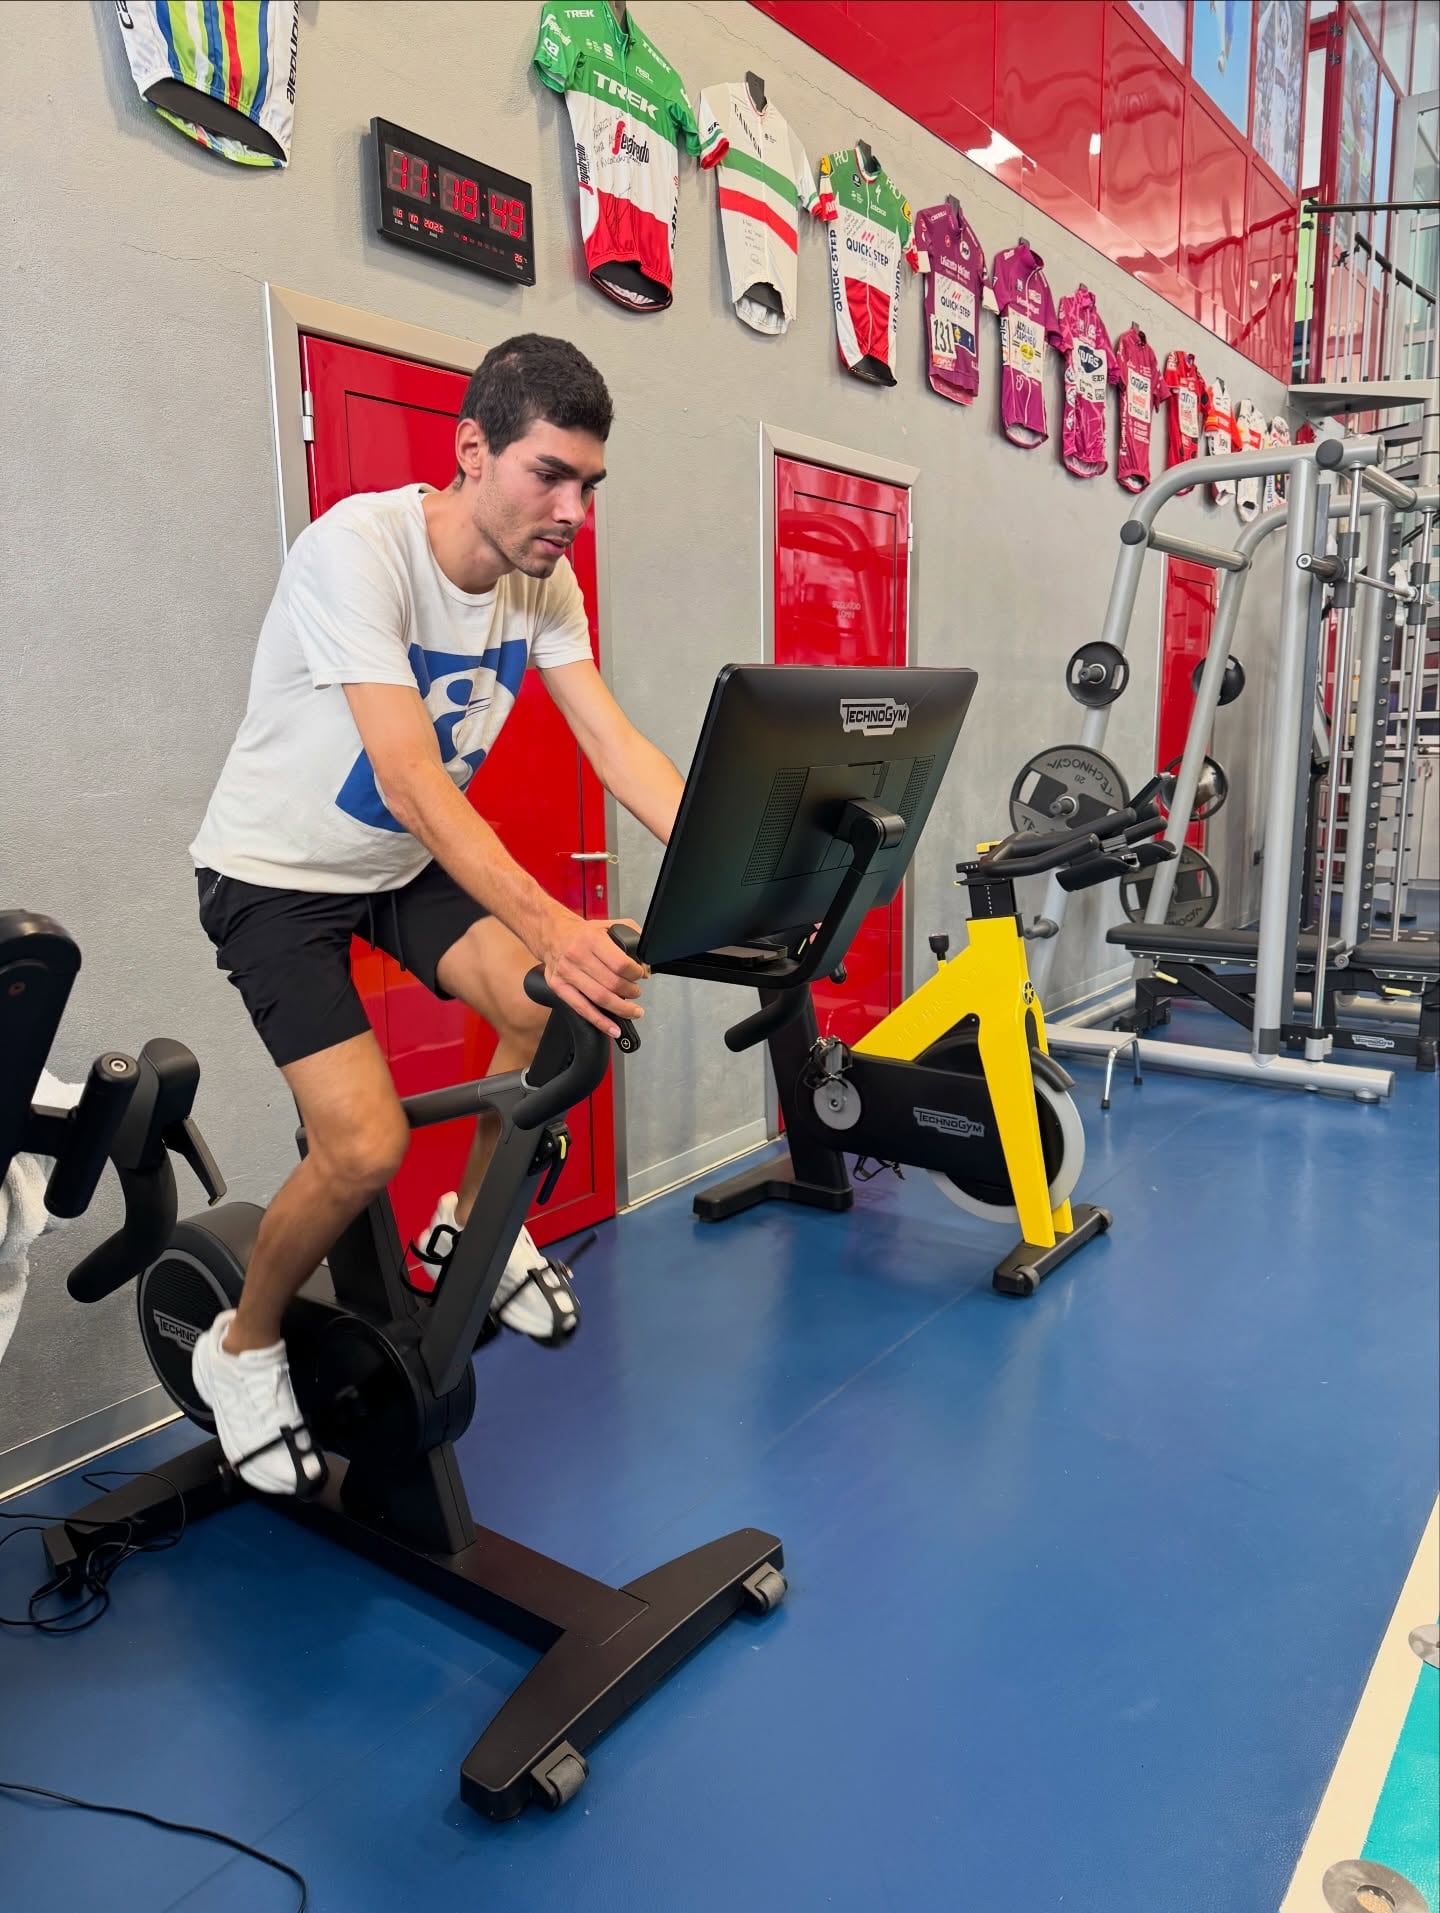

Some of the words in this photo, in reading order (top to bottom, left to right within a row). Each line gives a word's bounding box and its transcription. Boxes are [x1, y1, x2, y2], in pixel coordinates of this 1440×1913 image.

[564, 9, 595, 18] TREK
[593, 70, 659, 121] TREK
[829, 229, 839, 262] STEP
[846, 237, 872, 258] QUICK
[874, 249, 889, 267] STEP
[832, 268, 843, 312] QUICK
[940, 295, 959, 316] QUICK
[959, 305, 971, 318] STEP
[933, 319, 954, 354] 131
[842, 703, 907, 729] TECHNOGYM
[915, 1110, 983, 1133] TECHNOGYM
